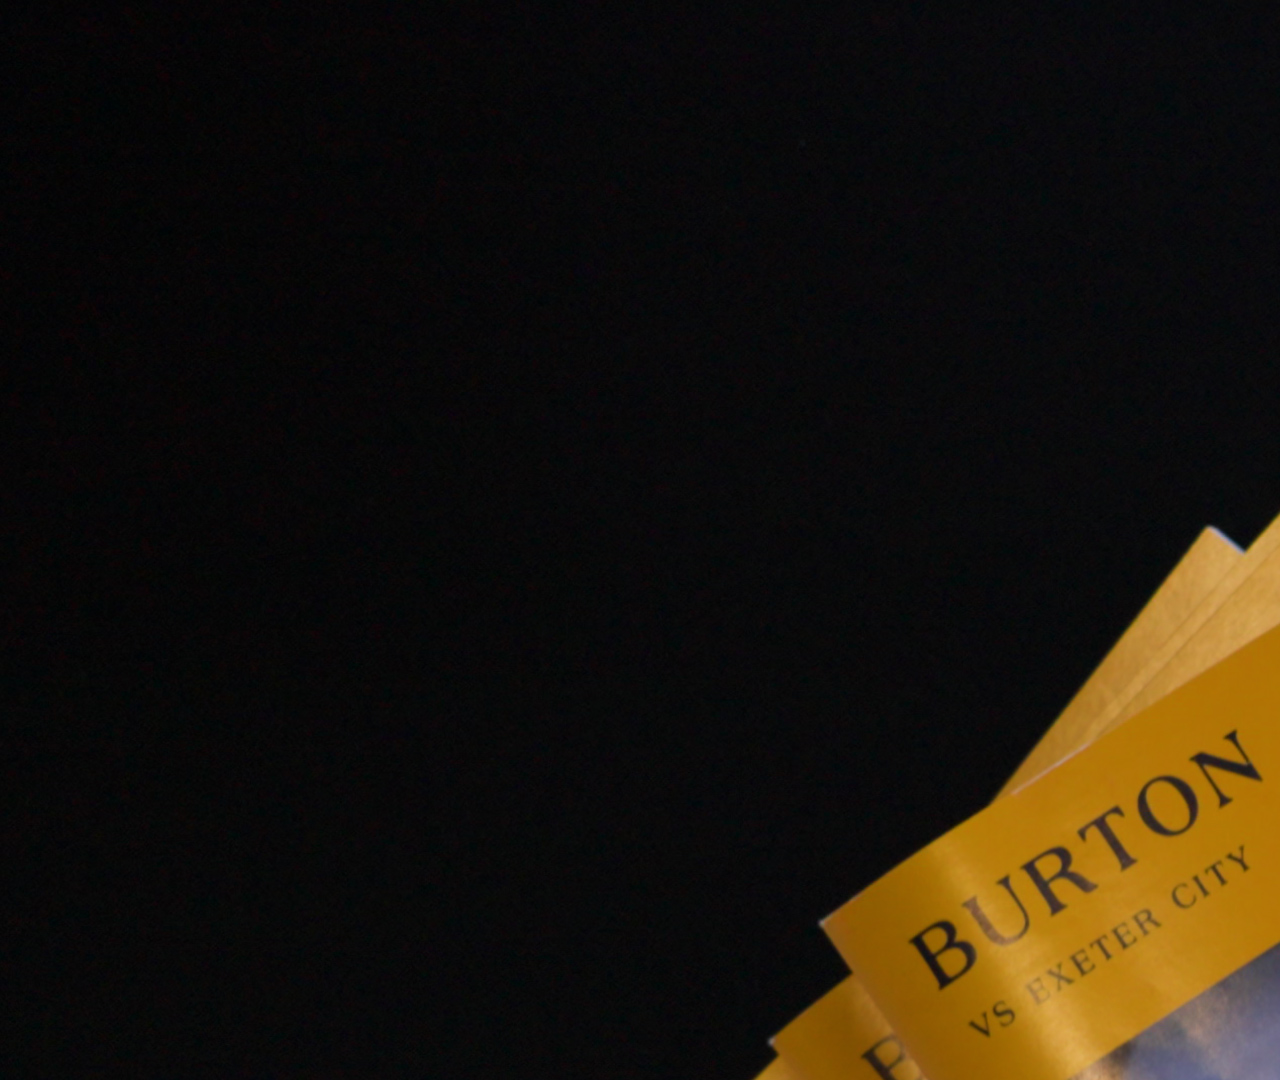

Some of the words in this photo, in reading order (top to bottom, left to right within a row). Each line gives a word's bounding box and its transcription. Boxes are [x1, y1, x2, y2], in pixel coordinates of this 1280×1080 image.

[907, 729, 1263, 992] BURTON
[968, 1000, 1016, 1039] VS
[1025, 907, 1162, 1006] EXETER
[1171, 845, 1251, 910] CITY
